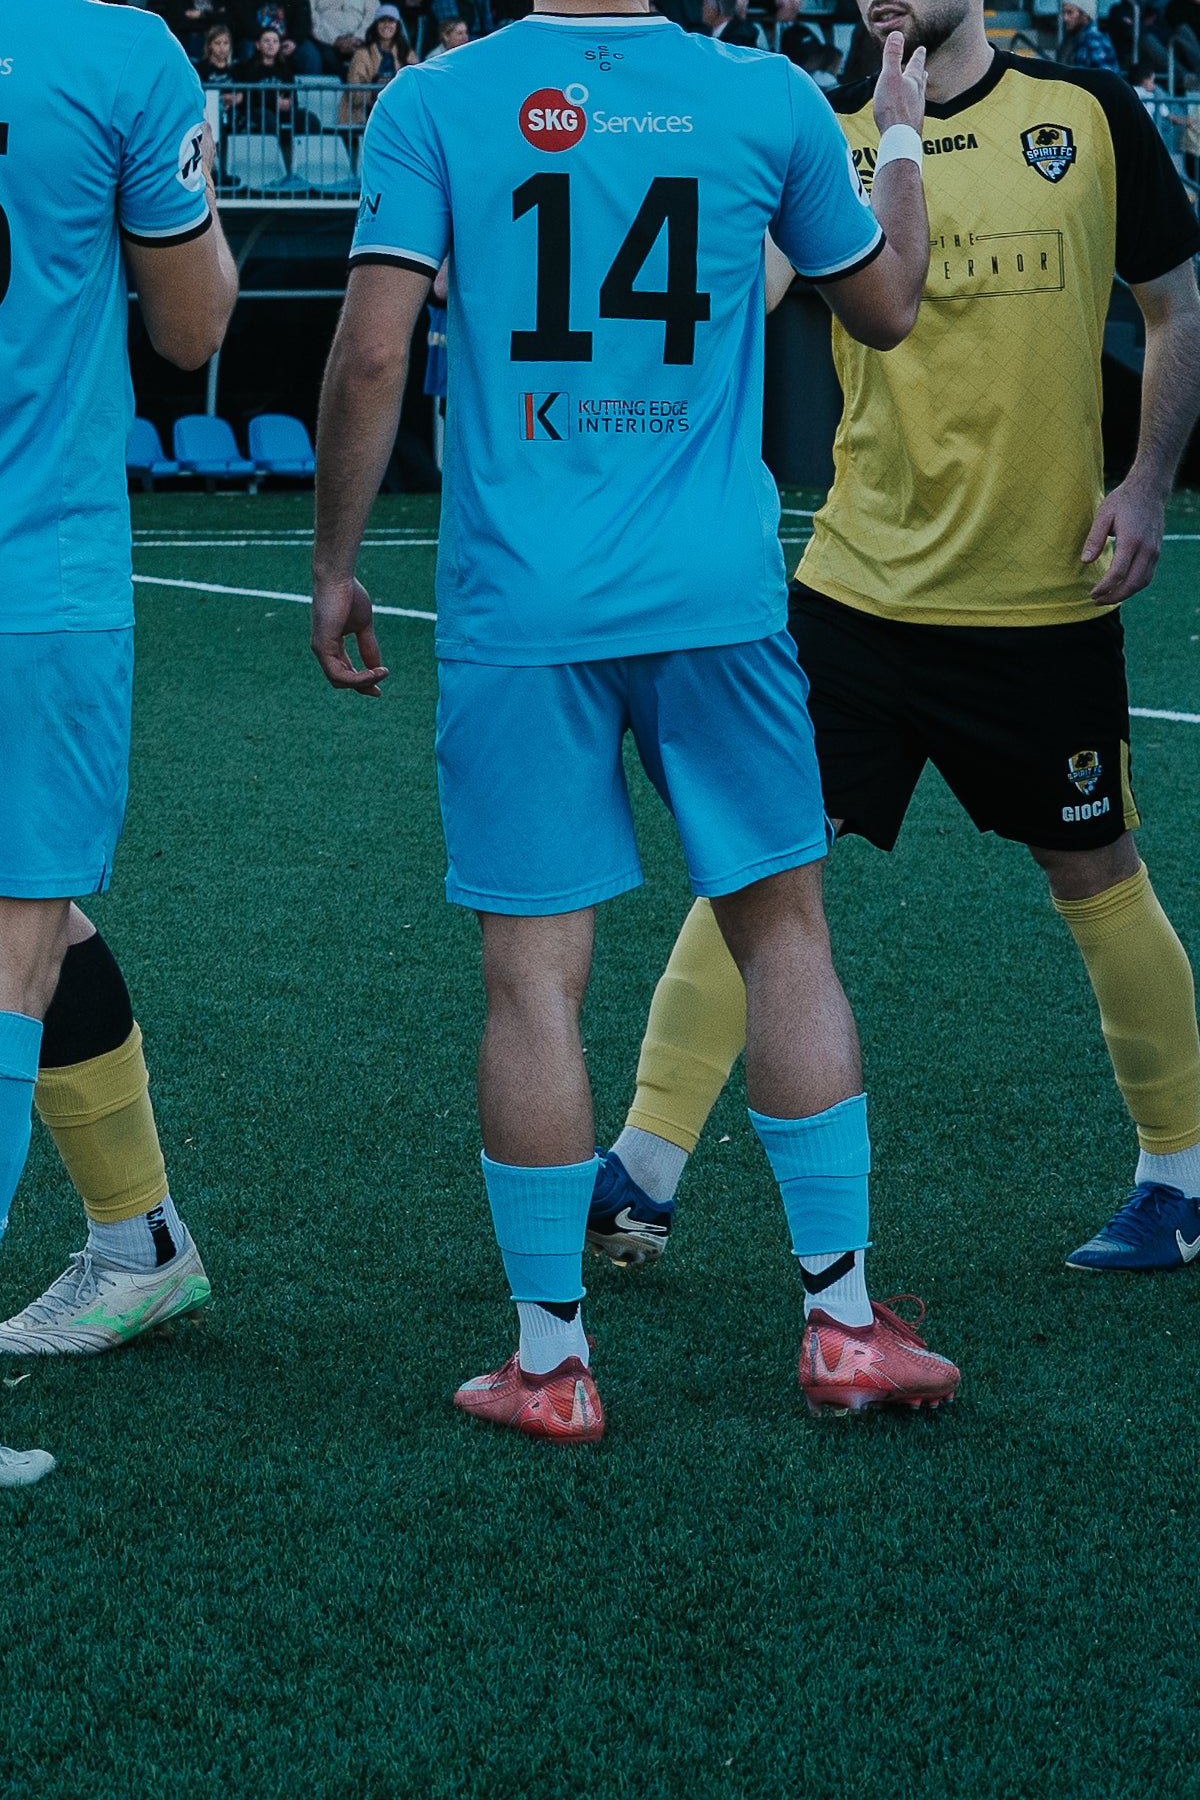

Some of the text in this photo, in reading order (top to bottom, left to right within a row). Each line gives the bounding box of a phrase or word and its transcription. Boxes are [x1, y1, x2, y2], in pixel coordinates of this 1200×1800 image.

[528, 108, 694, 134] SKG Services
[922, 133, 979, 156] GIOCA
[1027, 146, 1073, 159] SPIRIT FC
[940, 233, 975, 249] THE
[511, 173, 711, 365] 14
[944, 252, 1048, 280] ERNOR
[649, 400, 689, 416] EDGE
[577, 417, 690, 434] INTERIORS
[1062, 796, 1110, 823] GIOCA
